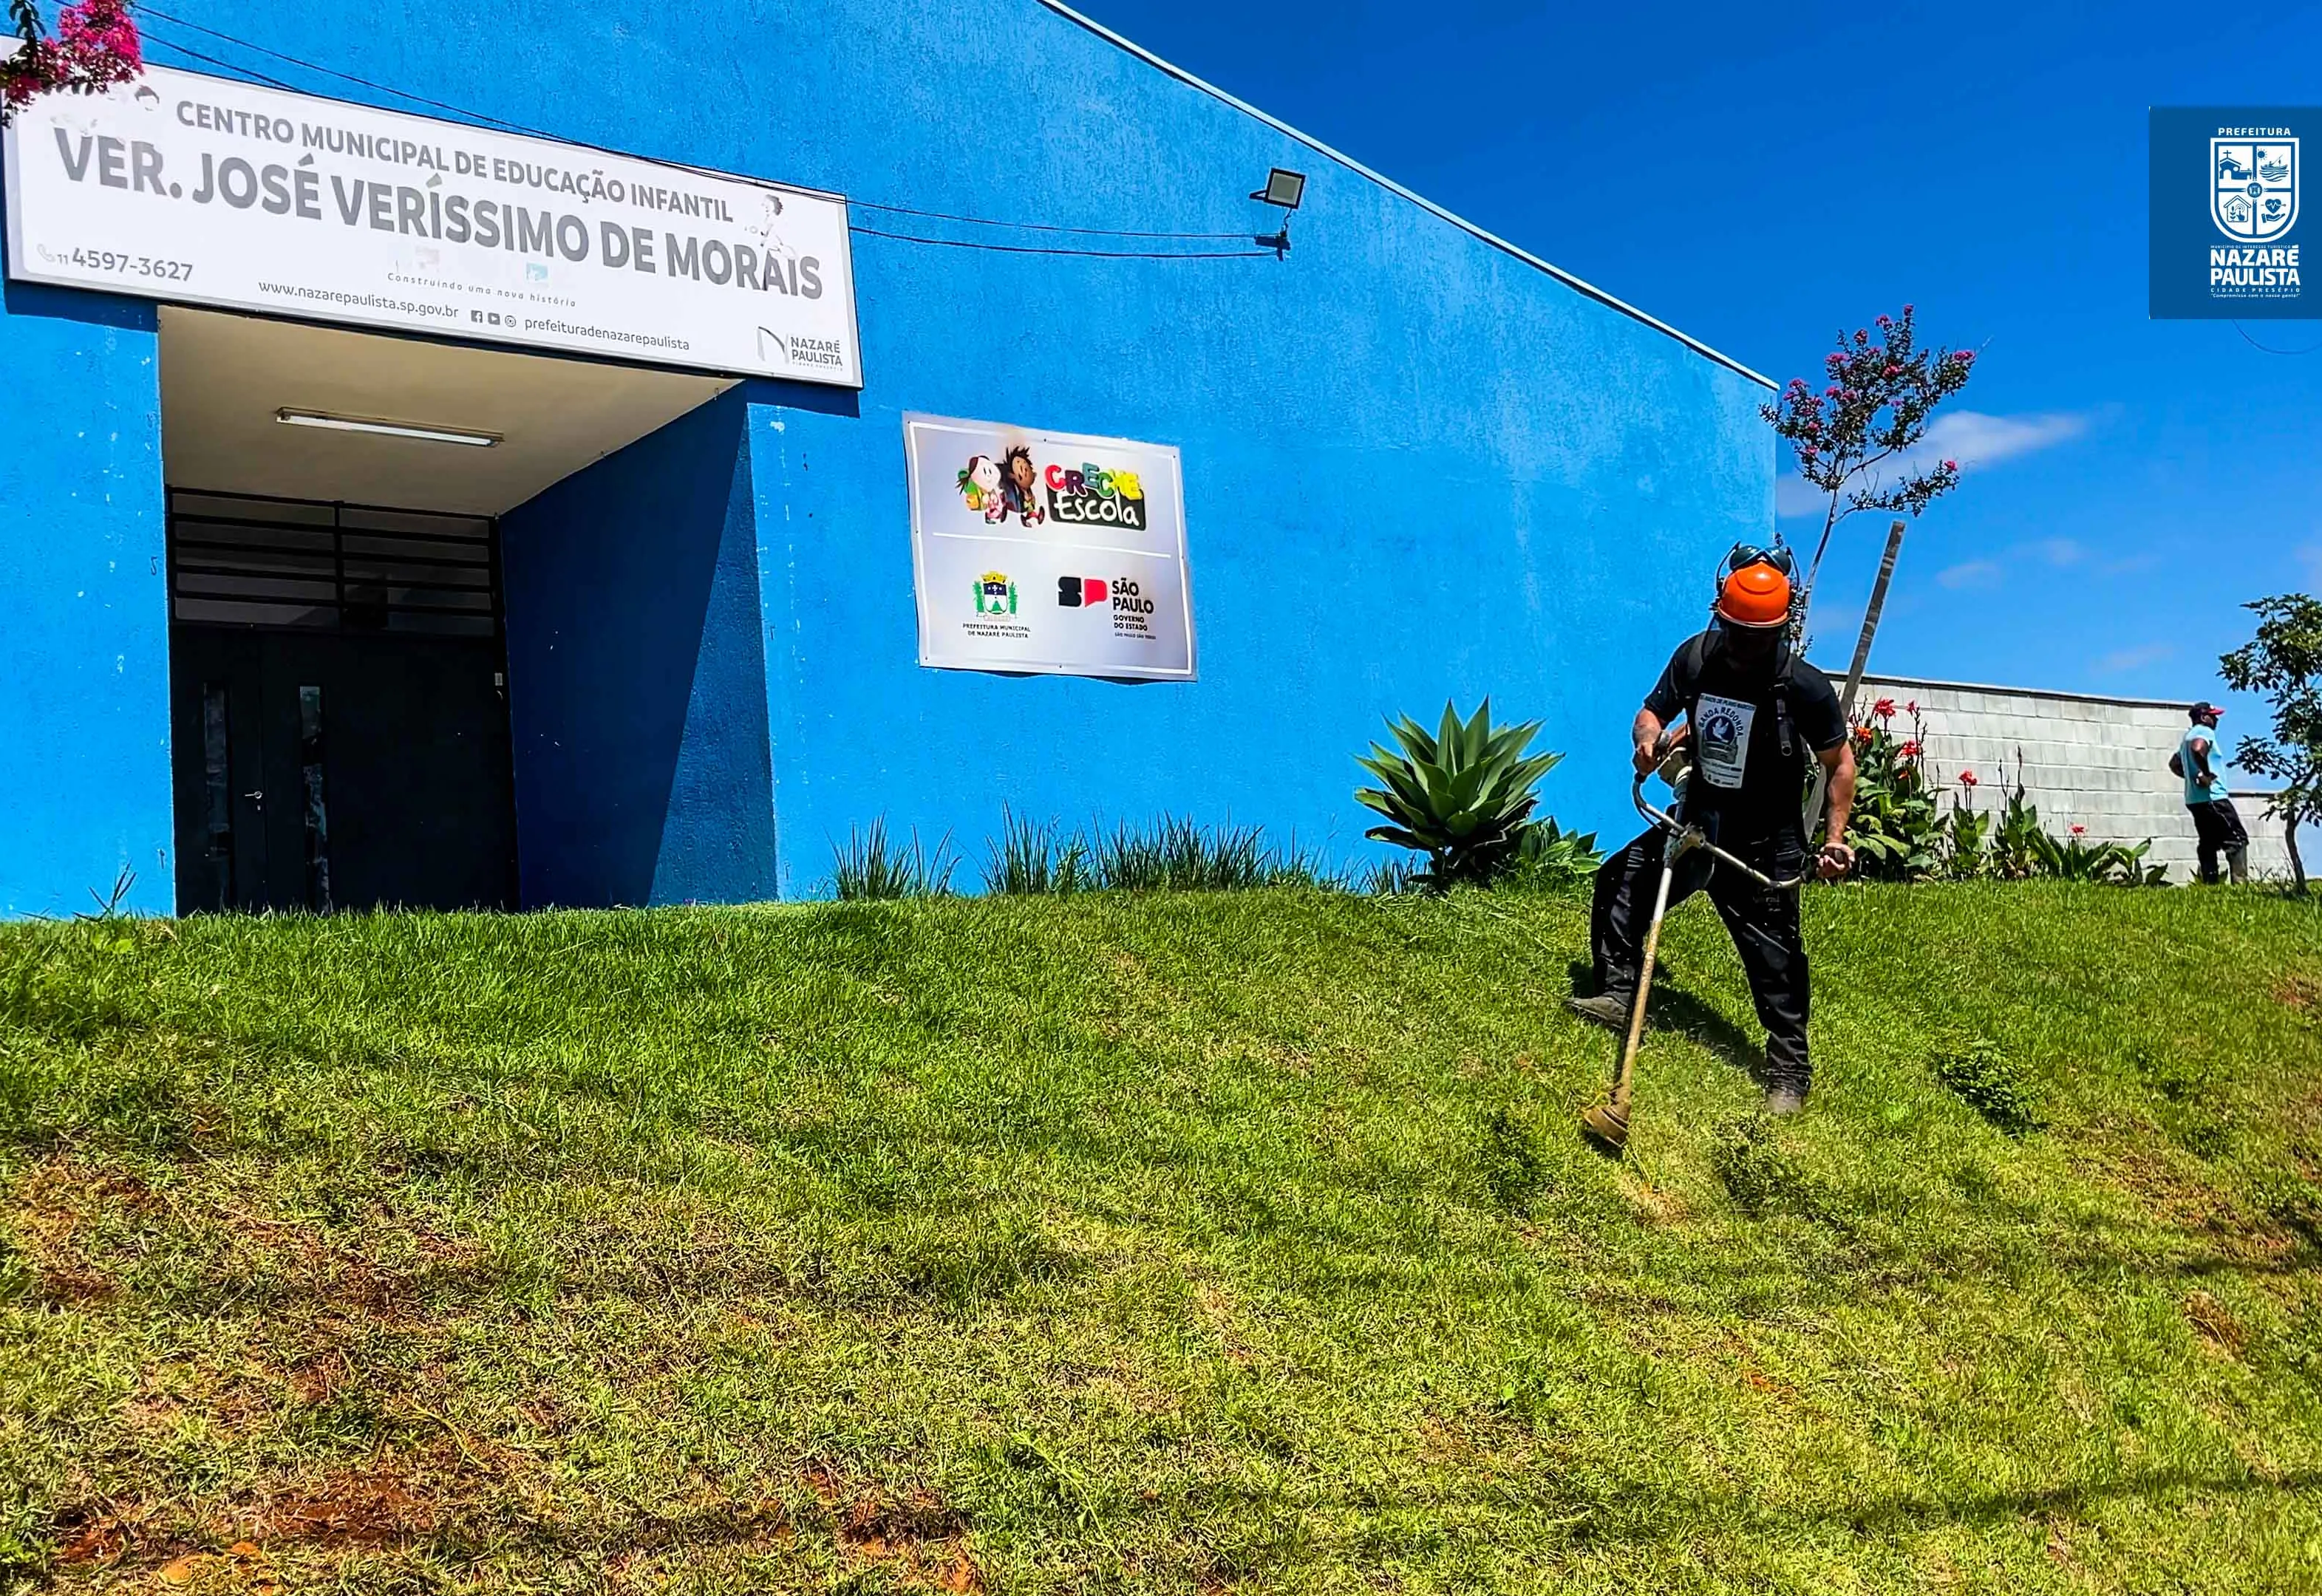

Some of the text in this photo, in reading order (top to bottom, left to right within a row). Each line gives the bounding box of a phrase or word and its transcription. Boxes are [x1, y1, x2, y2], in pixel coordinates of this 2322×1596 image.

[177, 100, 734, 223] CENTRO MUNICIPAL DE EDUCAÇÃO INFANTIL
[53, 127, 823, 300] VER. JOSÉ VERÍSSIMO DE MORAIS
[57, 247, 193, 282] 11 4597-3627
[258, 282, 459, 317] www.nazarepaulista.sp.gov.br
[387, 273, 576, 307] Construindo uma nova história
[524, 318, 690, 350] prefeituradenazarepaulista
[790, 336, 840, 353] NAZARÉ
[791, 349, 843, 366] PAULISTA
[1043, 462, 1143, 500] CRECHE
[1054, 493, 1140, 527] Escola
[1111, 577, 1139, 596] SÃO
[1112, 597, 1154, 614] PAULO
[1113, 615, 1145, 623] GOVERNO
[1126, 623, 1148, 631] ESTADO
